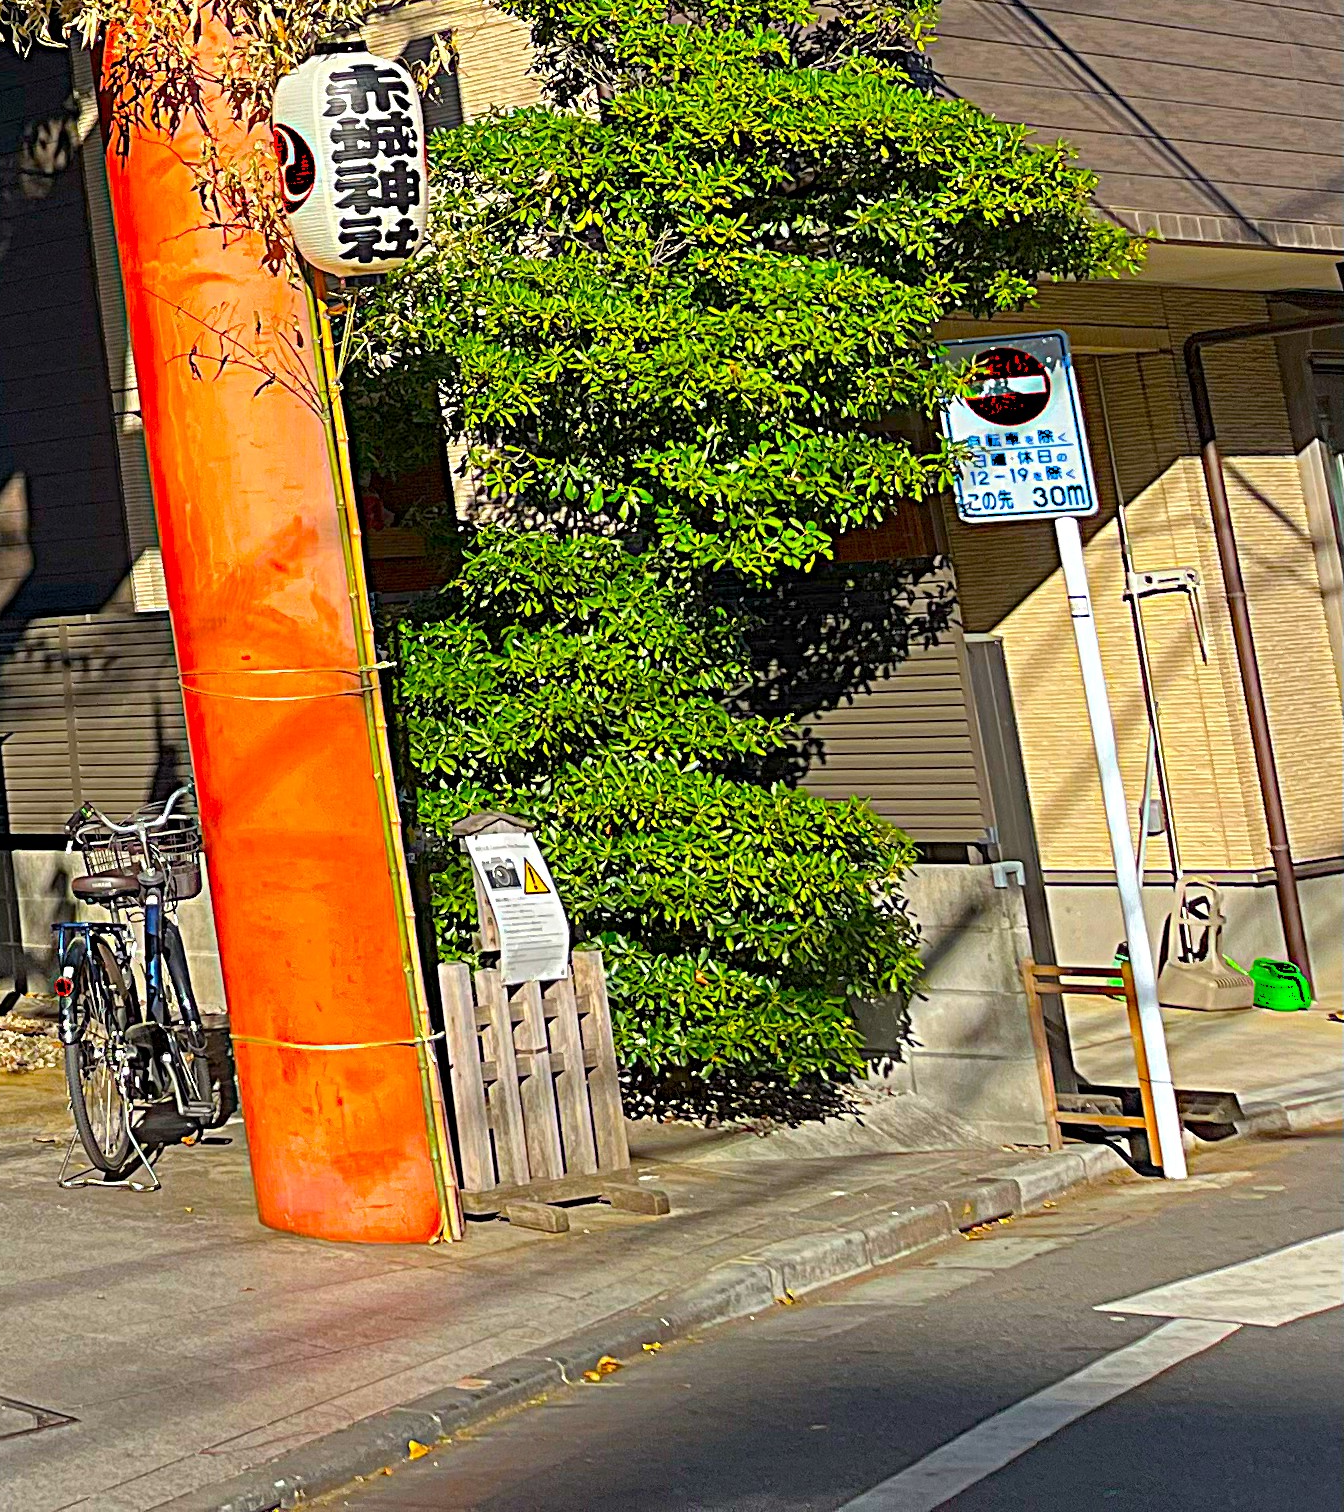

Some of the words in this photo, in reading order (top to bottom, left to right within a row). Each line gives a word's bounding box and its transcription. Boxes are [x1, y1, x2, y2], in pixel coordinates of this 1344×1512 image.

[322, 64, 421, 264] 赤城神社
[967, 490, 1014, 511] この先
[1032, 484, 1086, 508] 30m
